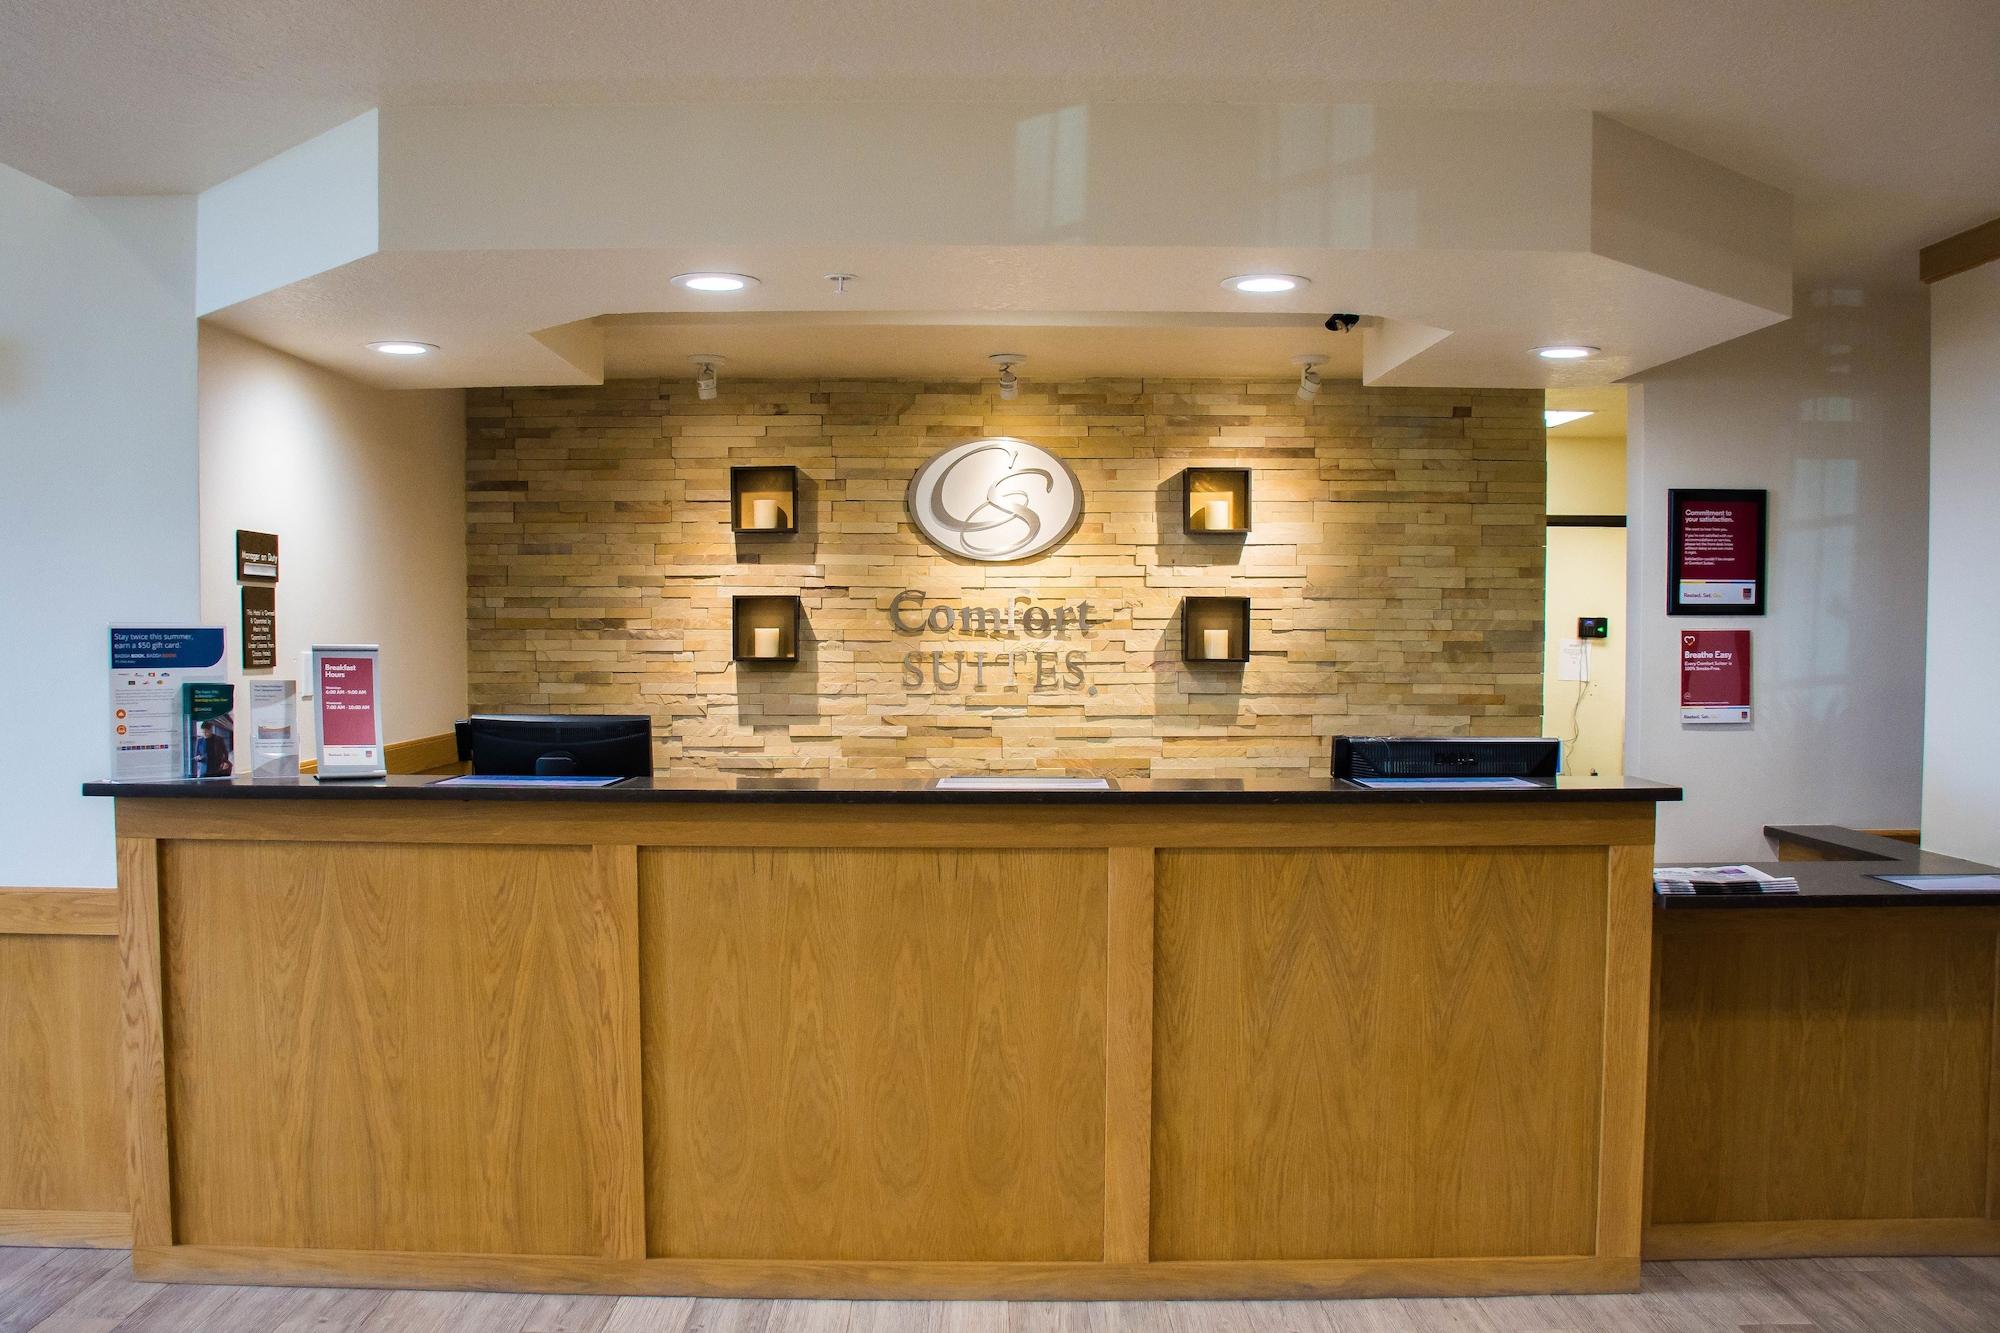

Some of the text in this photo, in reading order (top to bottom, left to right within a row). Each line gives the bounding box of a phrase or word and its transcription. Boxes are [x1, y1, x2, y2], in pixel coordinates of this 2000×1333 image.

[242, 550, 260, 562] Manager
[267, 552, 278, 564] Duty
[890, 588, 1095, 636] Comfort
[114, 633, 129, 642] Stay
[151, 642, 163, 650] gift
[1684, 650, 1732, 660] Breathe Easy
[325, 663, 357, 671] Breakfast
[325, 670, 346, 678] Hours
